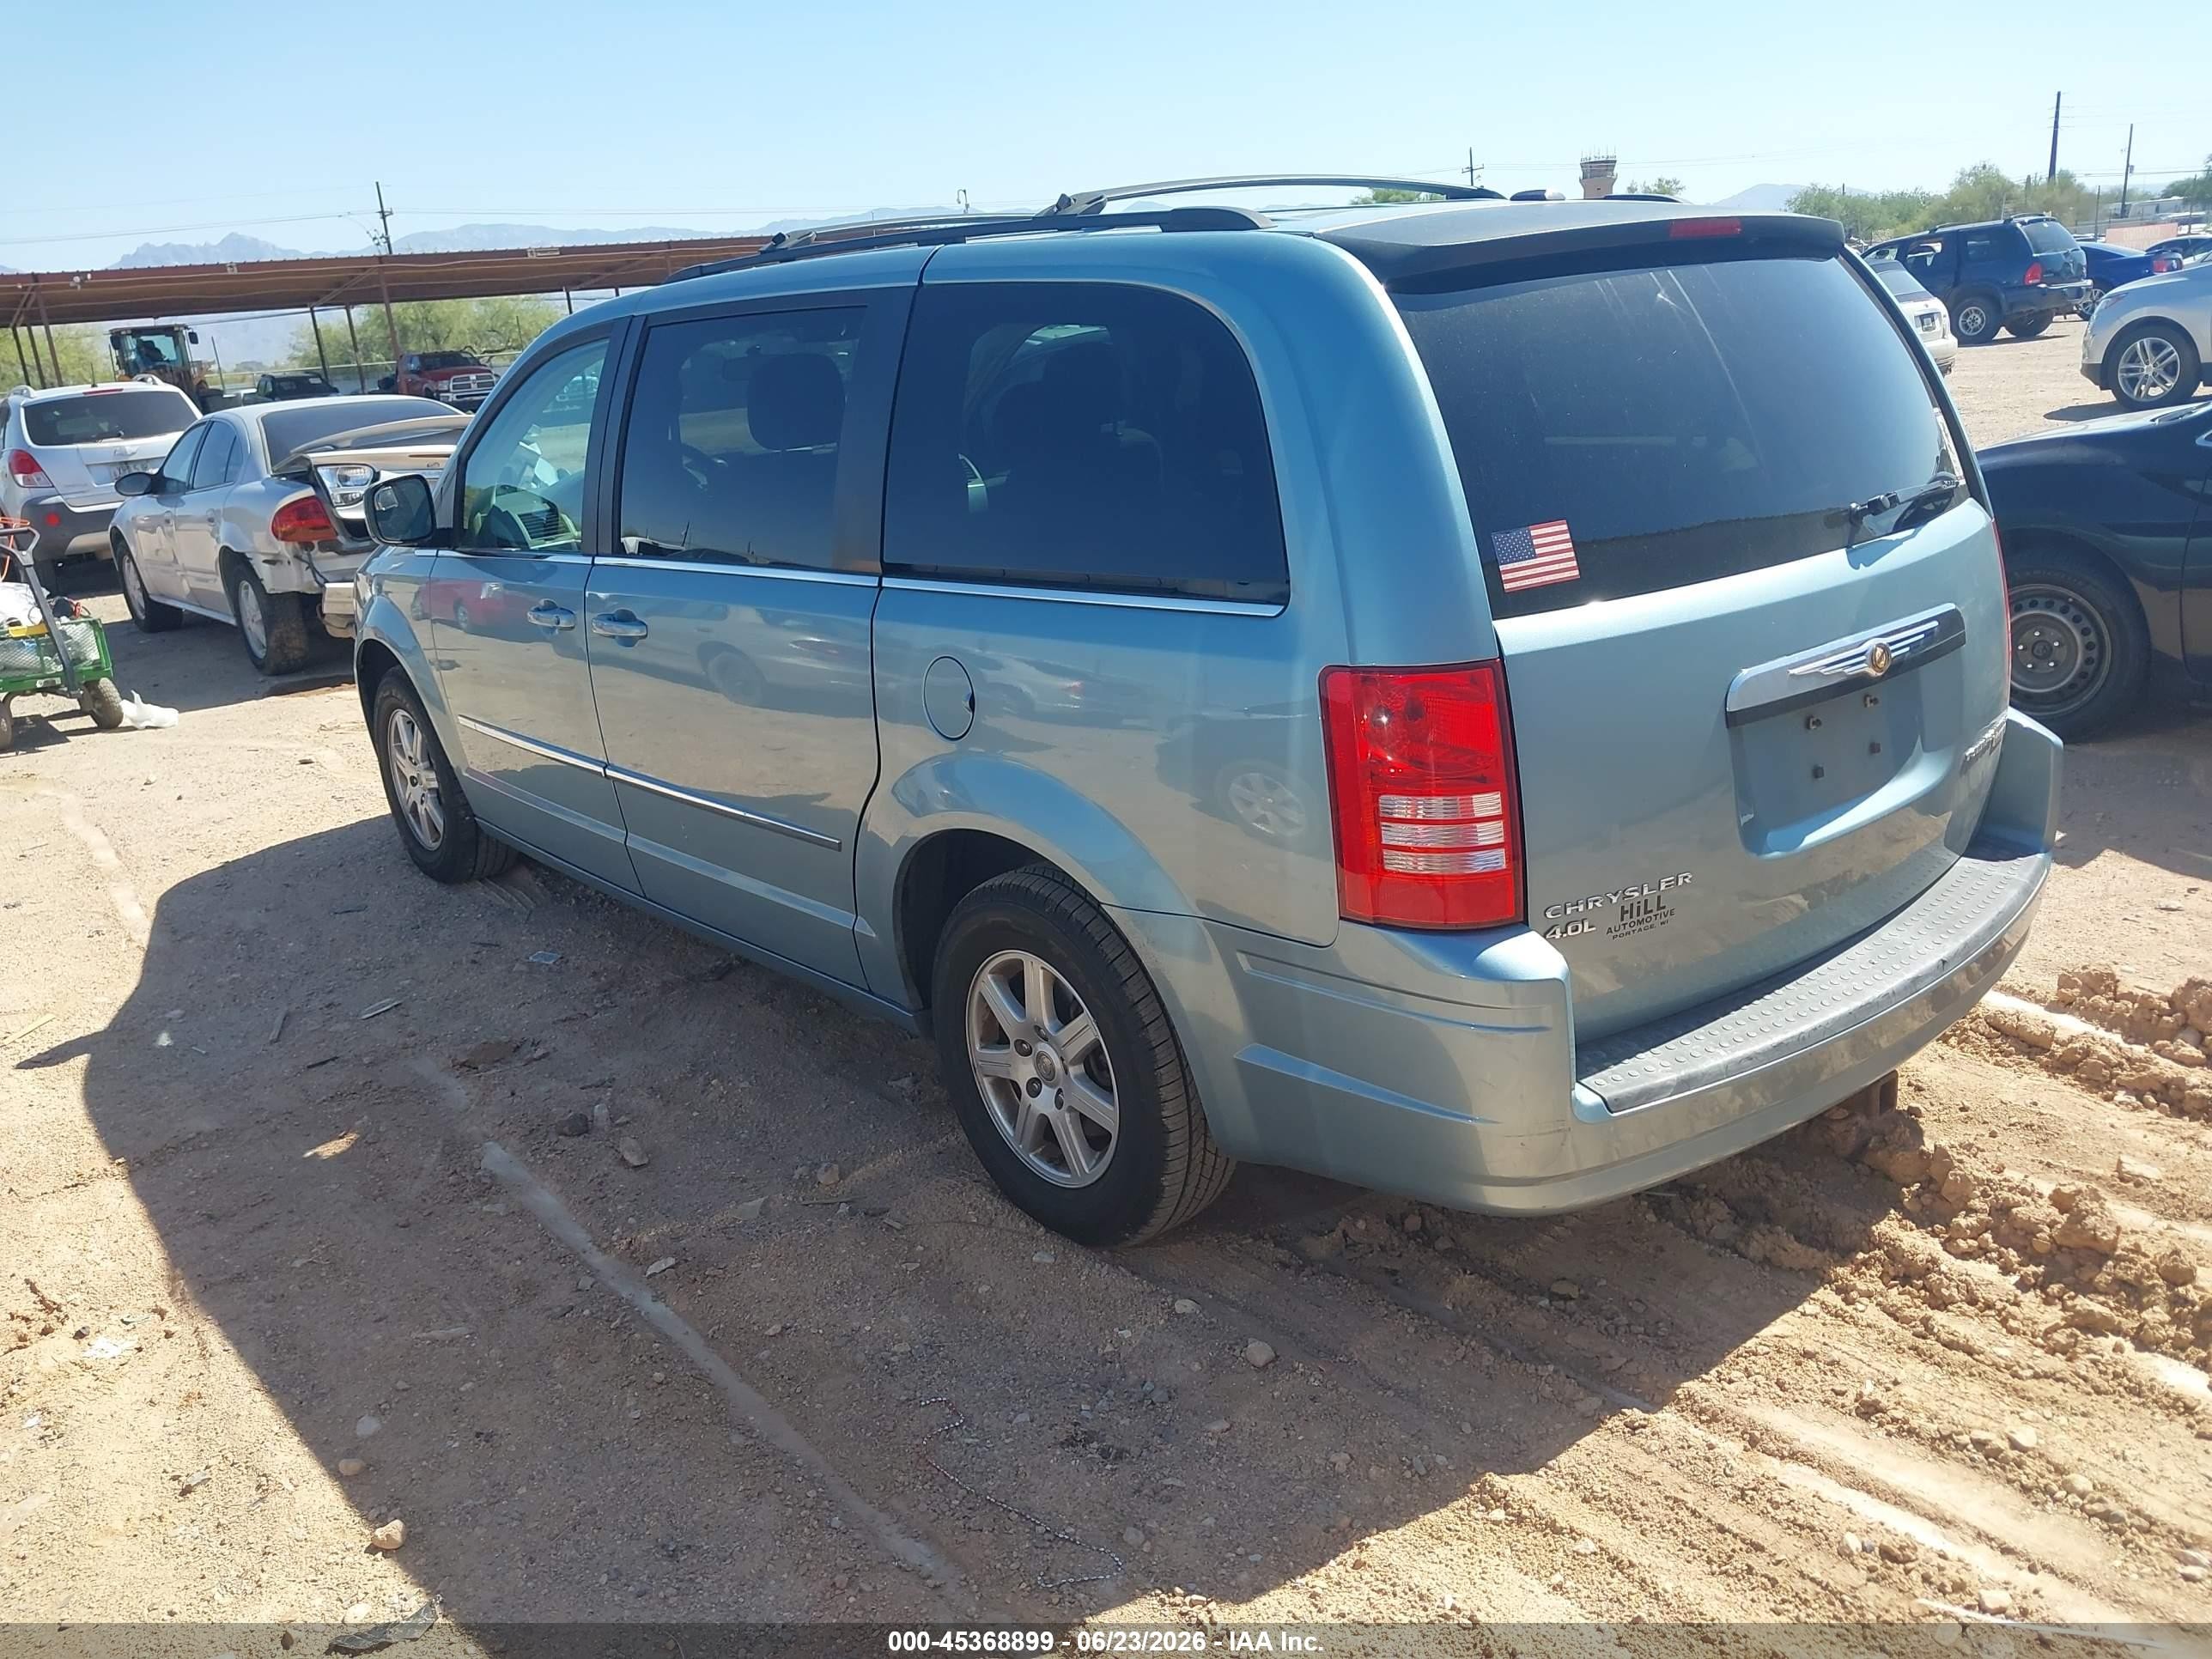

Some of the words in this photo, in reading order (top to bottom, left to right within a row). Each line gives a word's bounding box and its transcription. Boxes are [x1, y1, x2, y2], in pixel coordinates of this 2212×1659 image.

[1545, 872, 1692, 919] CHRYSLER
[1545, 918, 1596, 939] 4.0L
[1606, 908, 1675, 934] AUTOMOTIVE
